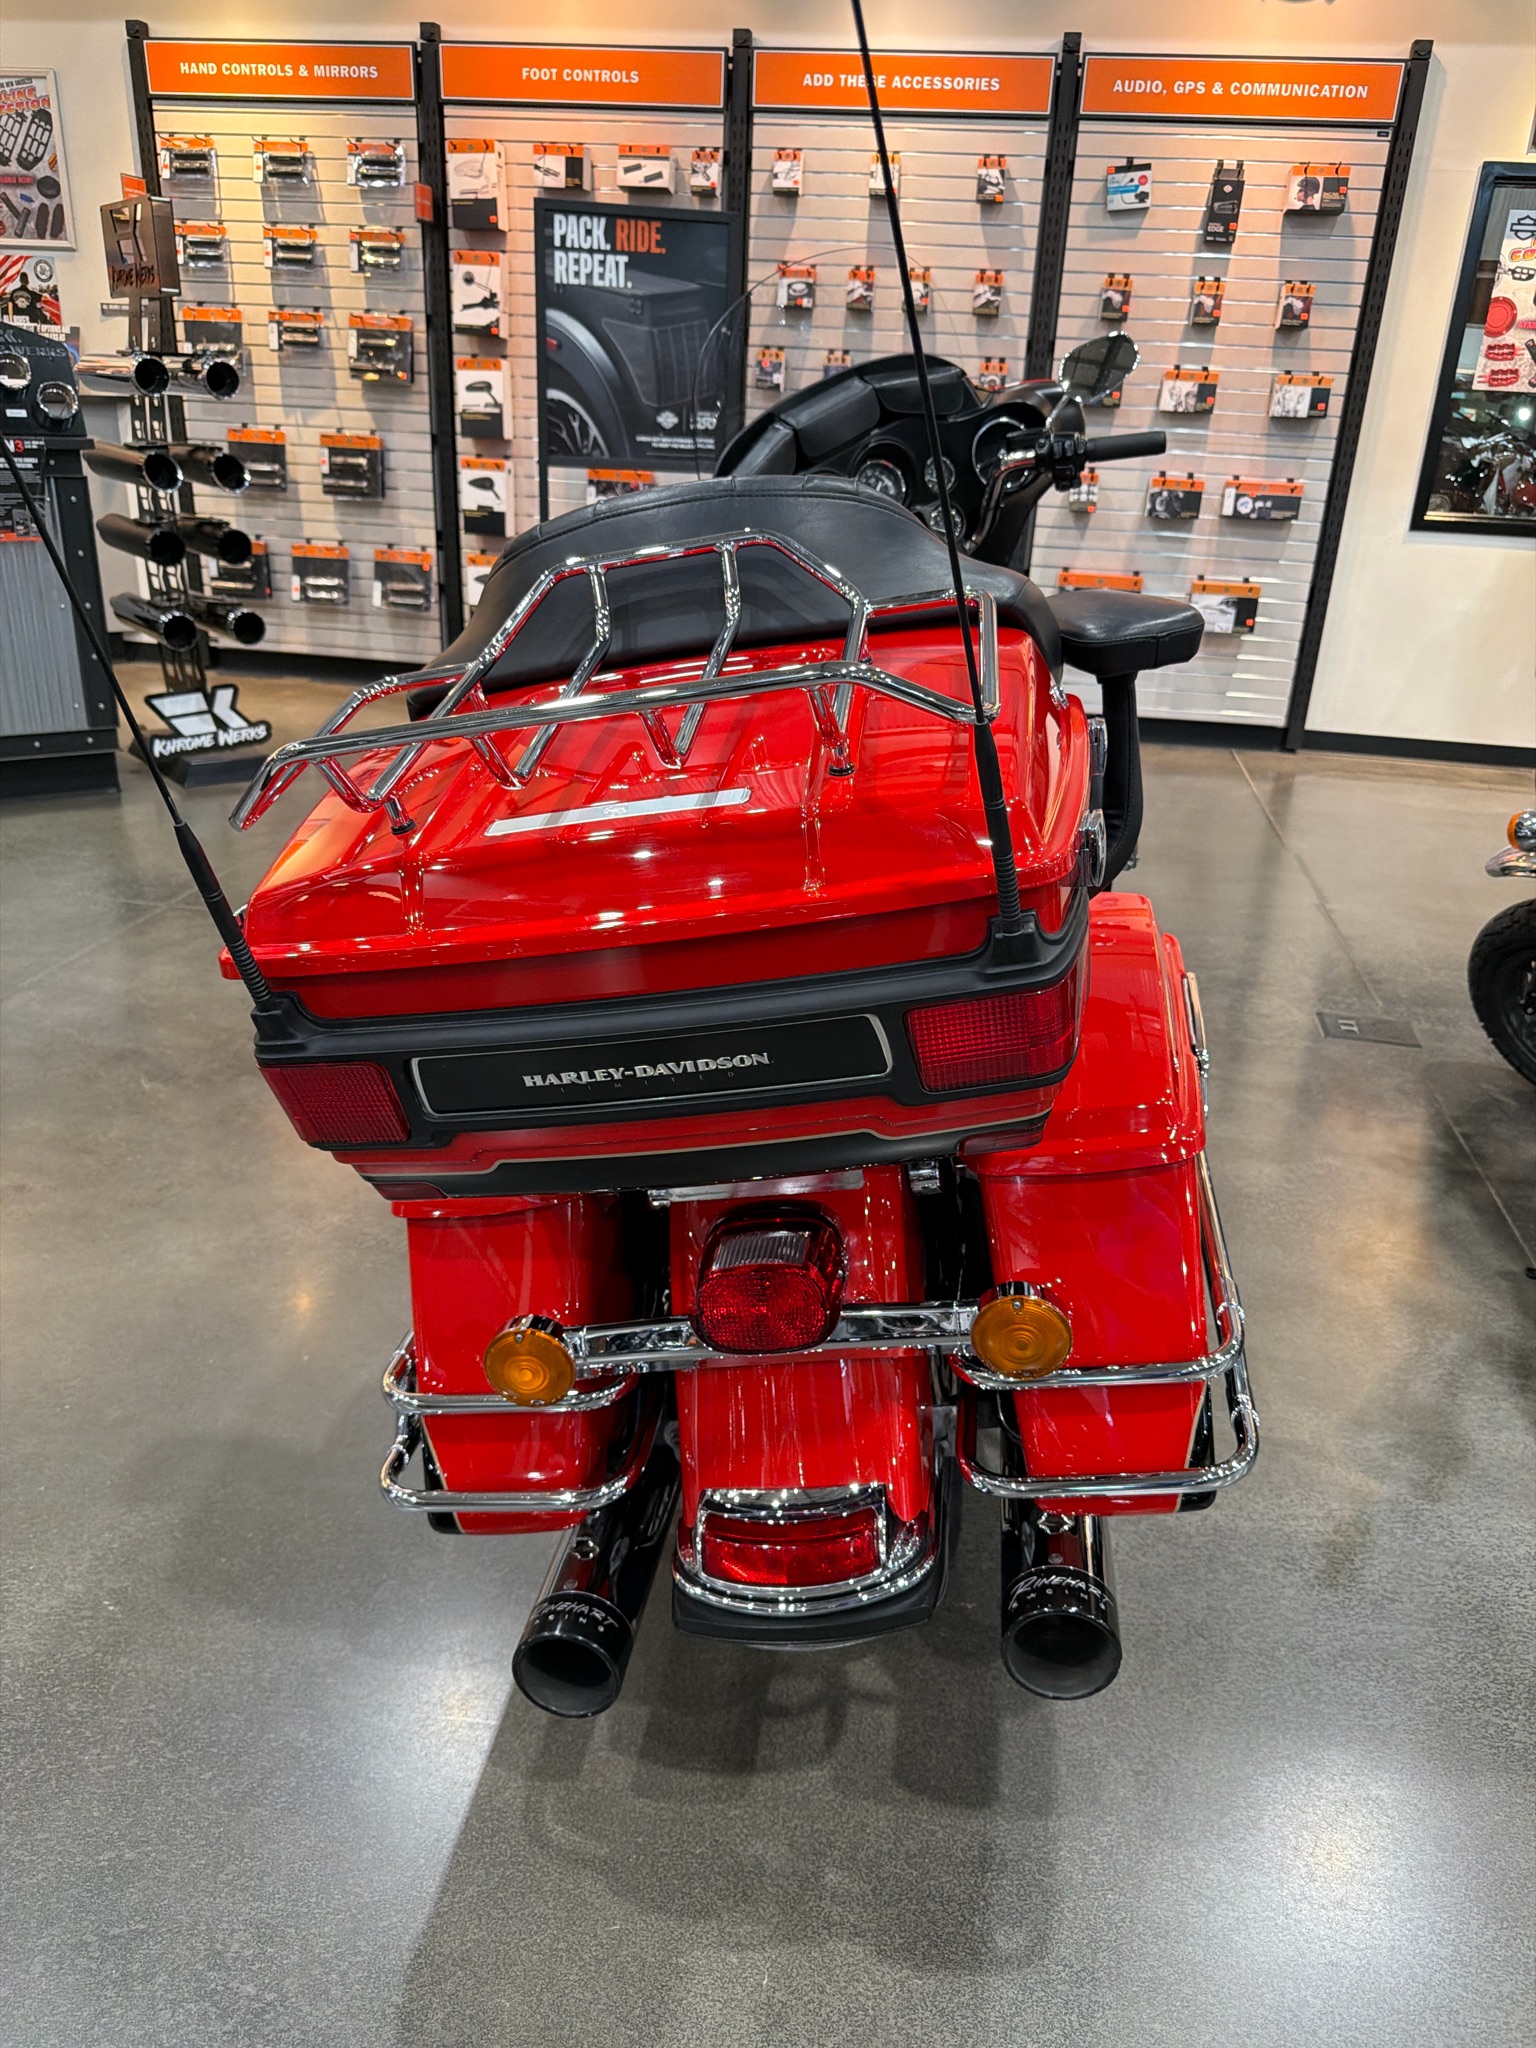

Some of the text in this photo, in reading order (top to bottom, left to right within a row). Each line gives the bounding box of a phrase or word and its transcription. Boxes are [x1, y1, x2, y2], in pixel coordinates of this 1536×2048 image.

[179, 62, 379, 78] HAND CONTROLS & MIRRORS
[521, 67, 639, 83] FOOT CONTROLS
[803, 73, 834, 87] ADD
[891, 75, 1000, 91] ACCESSORIES
[1113, 79, 1369, 99] AUDIO, GPS & COMMUNICATION
[553, 213, 667, 254] PACK. RIDE.
[553, 250, 633, 289] REPEAT.
[217, 723, 268, 747] WERKS
[521, 1052, 772, 1088] HARLEY-DAVIDSON
[560, 1071, 735, 1093] LIMITED
[1008, 1574, 1114, 1611] RINEHART
